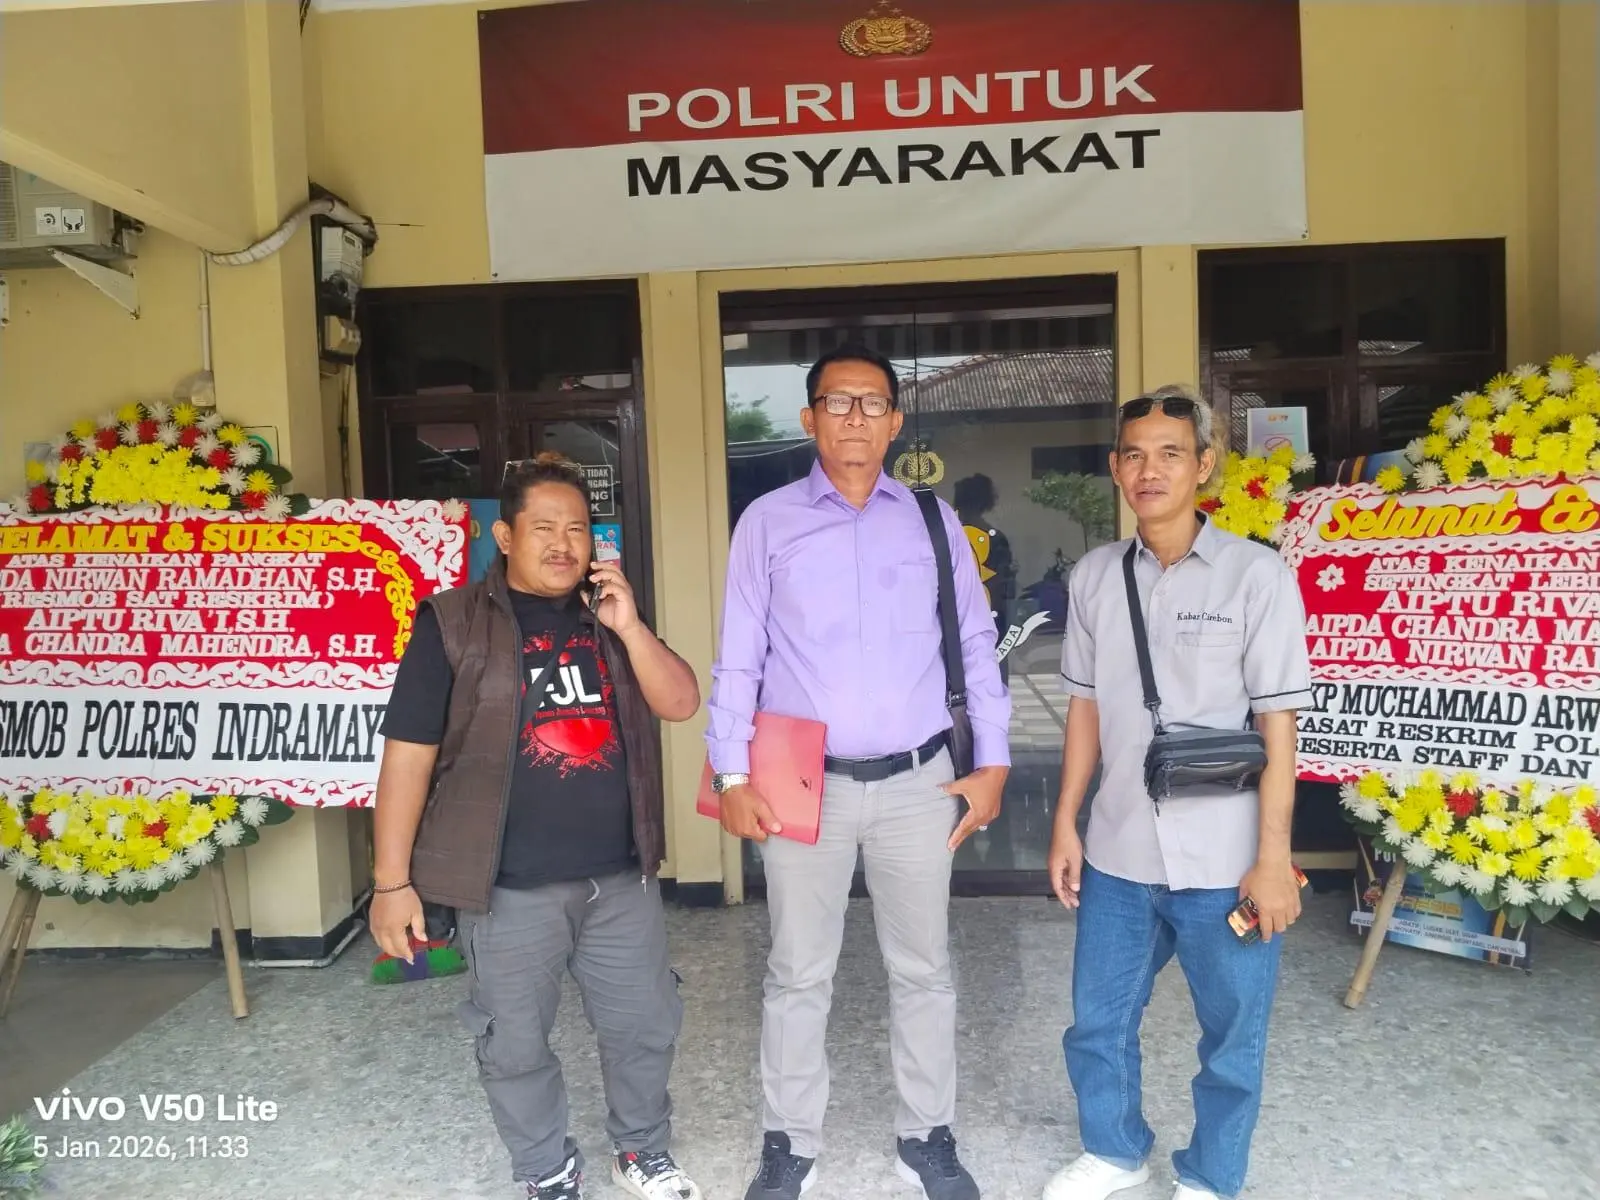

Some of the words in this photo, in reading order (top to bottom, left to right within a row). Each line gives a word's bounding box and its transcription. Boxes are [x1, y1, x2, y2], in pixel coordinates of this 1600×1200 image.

[627, 81, 854, 133] POLRI
[885, 64, 1156, 118] UNTUK
[627, 128, 1161, 197] MASYARAKAT
[1320, 488, 1522, 542] Selamat
[1540, 485, 1600, 533] &
[0, 525, 157, 554] ELAMAT
[162, 523, 194, 552] &
[201, 524, 362, 552] SUKSES
[5, 554, 65, 568] ATAS
[72, 553, 203, 568] KENAIKAN
[211, 553, 325, 567] PANGKAT
[1365, 556, 1430, 573] ATAS
[1443, 551, 1600, 573] KENAIKAN
[43, 568, 149, 591] NIRWAN
[1363, 573, 1514, 592] SETINGKAT
[0, 590, 117, 608] RESMOB
[125, 590, 179, 608] SAT
[1377, 591, 1501, 616] AIPTU
[1508, 591, 1600, 618] RIVA
[24, 608, 126, 631] AIPTU
[1177, 612, 1200, 621] Kabar
[1202, 612, 1233, 624] Cirebon
[1305, 613, 1385, 637] AIPDA
[1391, 614, 1542, 644] CHANDRA
[25, 632, 147, 656] CHANDRA
[158, 633, 320, 659] MAHENDRA,
[328, 633, 383, 659] S.H.
[997, 628, 1019, 657] ADA
[1309, 637, 1395, 662] AIPDA
[1404, 639, 1536, 670] NIRWAN
[1541, 644, 1600, 674] RA
[1339, 683, 1527, 726] MUCHAMMAD
[77, 699, 199, 761] POLRES
[212, 702, 388, 763] INDRAMAY
[1376, 721, 1518, 749] RESKRIM
[1533, 733, 1600, 756] POL
[1296, 737, 1402, 762] ESERTA
[1413, 745, 1509, 771] STAFF
[1520, 754, 1592, 779] DAN
